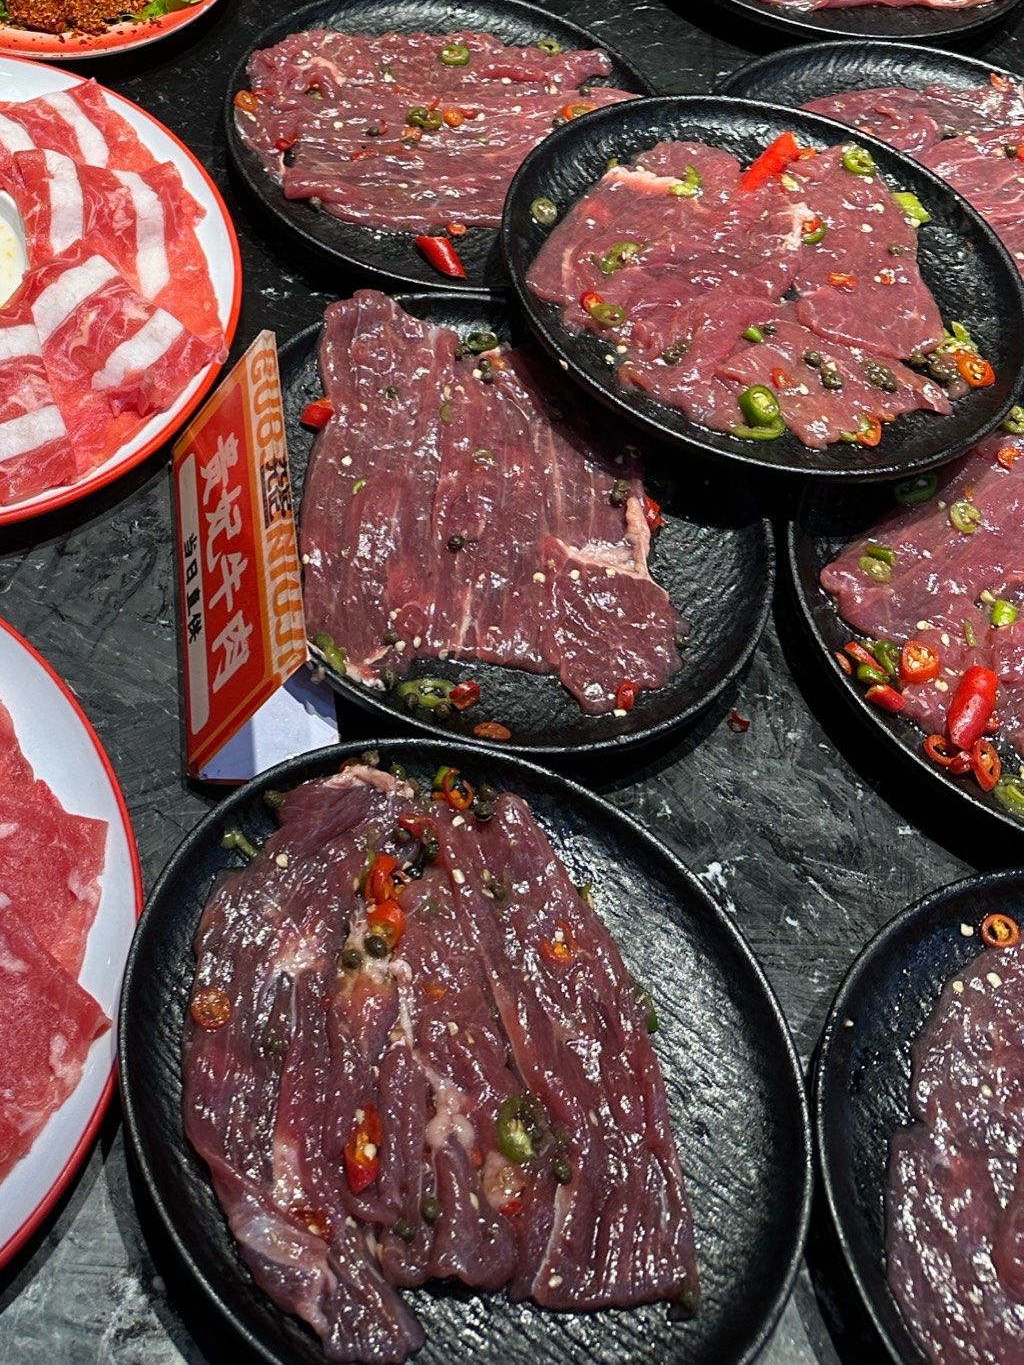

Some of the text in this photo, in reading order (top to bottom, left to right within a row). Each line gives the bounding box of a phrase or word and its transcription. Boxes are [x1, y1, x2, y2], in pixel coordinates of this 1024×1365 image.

[184, 532, 202, 644] 当日直供
[201, 431, 253, 693] 贵妃牛肉
